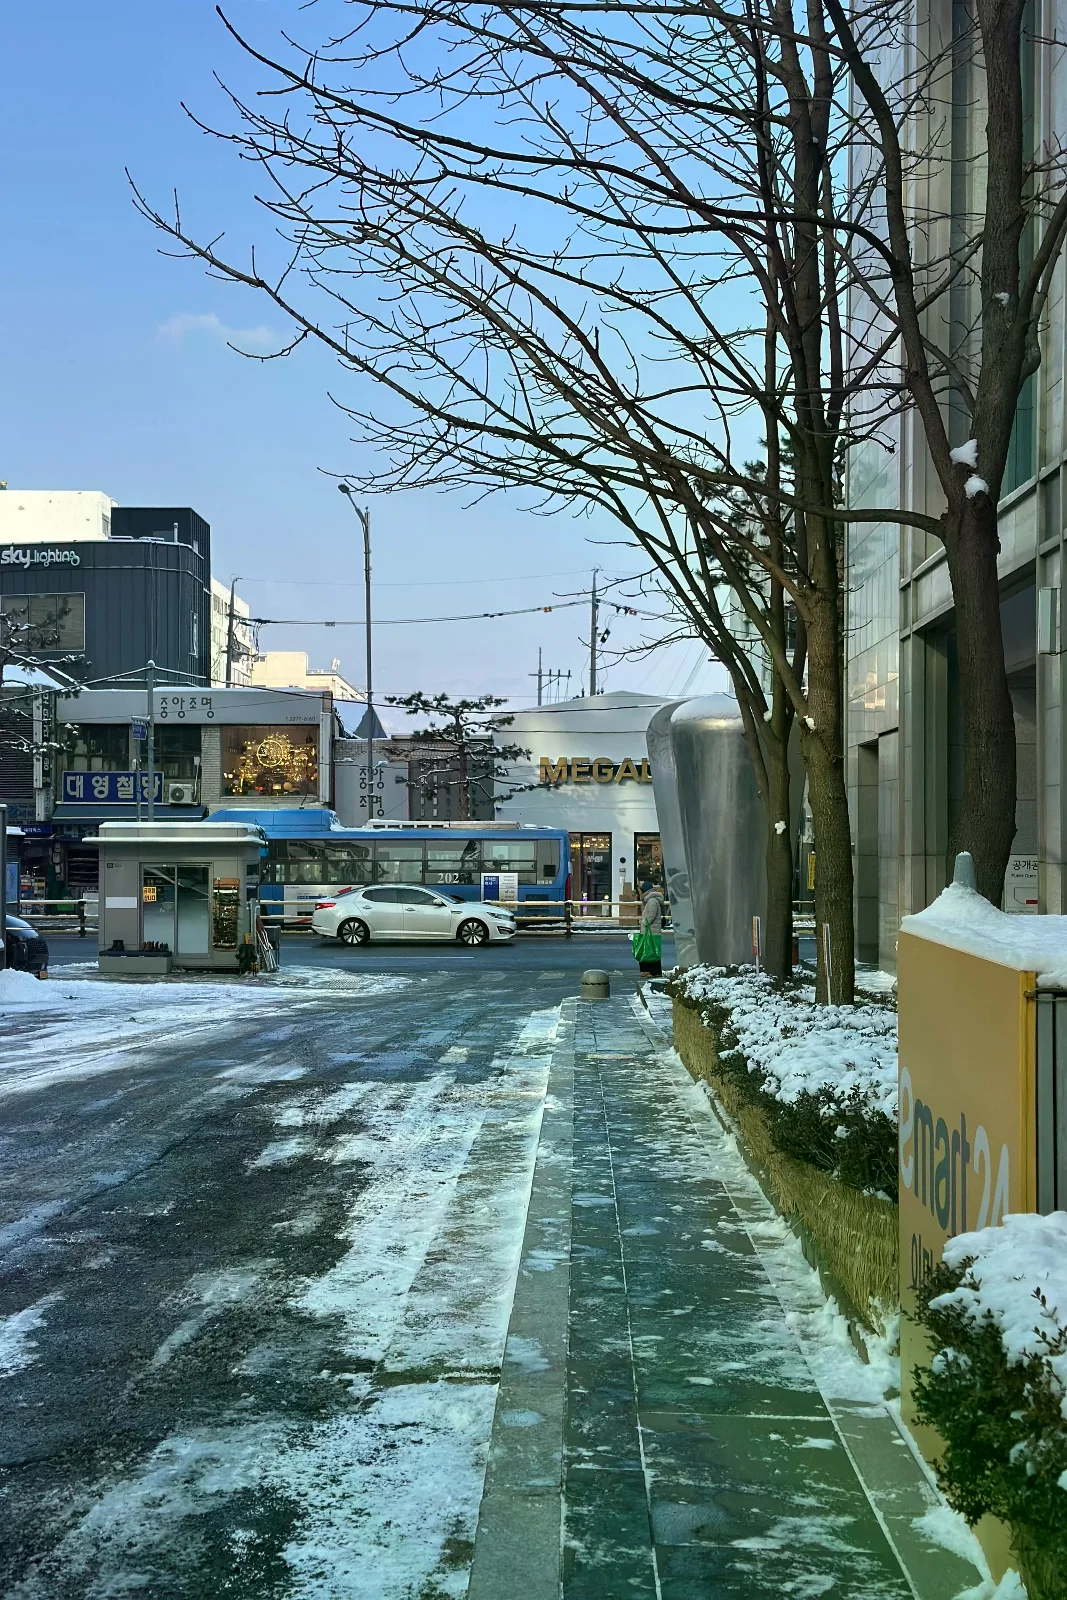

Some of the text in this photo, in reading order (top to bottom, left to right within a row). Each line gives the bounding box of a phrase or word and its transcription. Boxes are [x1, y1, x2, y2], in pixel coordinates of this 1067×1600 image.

[1, 546, 30, 568] sky
[160, 697, 215, 718] 중앙조명
[437, 872, 460, 883] 202
